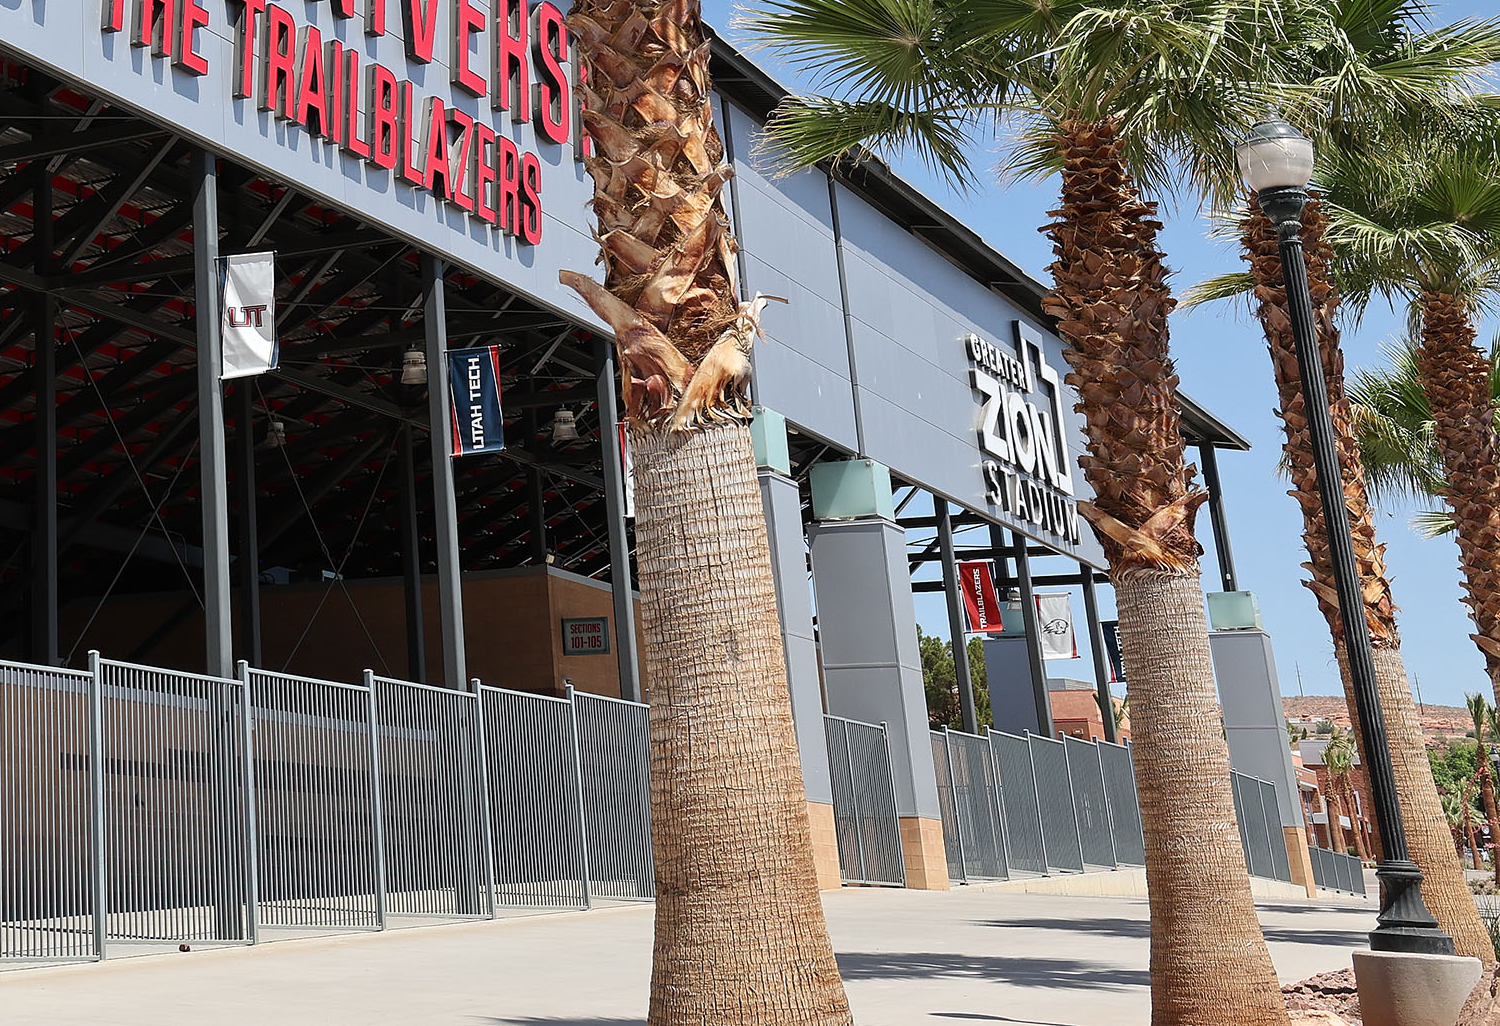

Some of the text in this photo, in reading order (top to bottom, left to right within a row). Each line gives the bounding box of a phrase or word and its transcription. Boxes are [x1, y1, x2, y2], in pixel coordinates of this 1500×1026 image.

[228, 304, 267, 327] UT
[966, 332, 1029, 391] GREATER
[467, 357, 485, 450] UTAH TECH
[969, 367, 1059, 489] ZION
[983, 460, 1083, 546] STADIUM
[570, 623, 601, 634] SECTIONS
[973, 568, 988, 629] TRAILBLAZERS
[571, 635, 602, 649] 101-105
